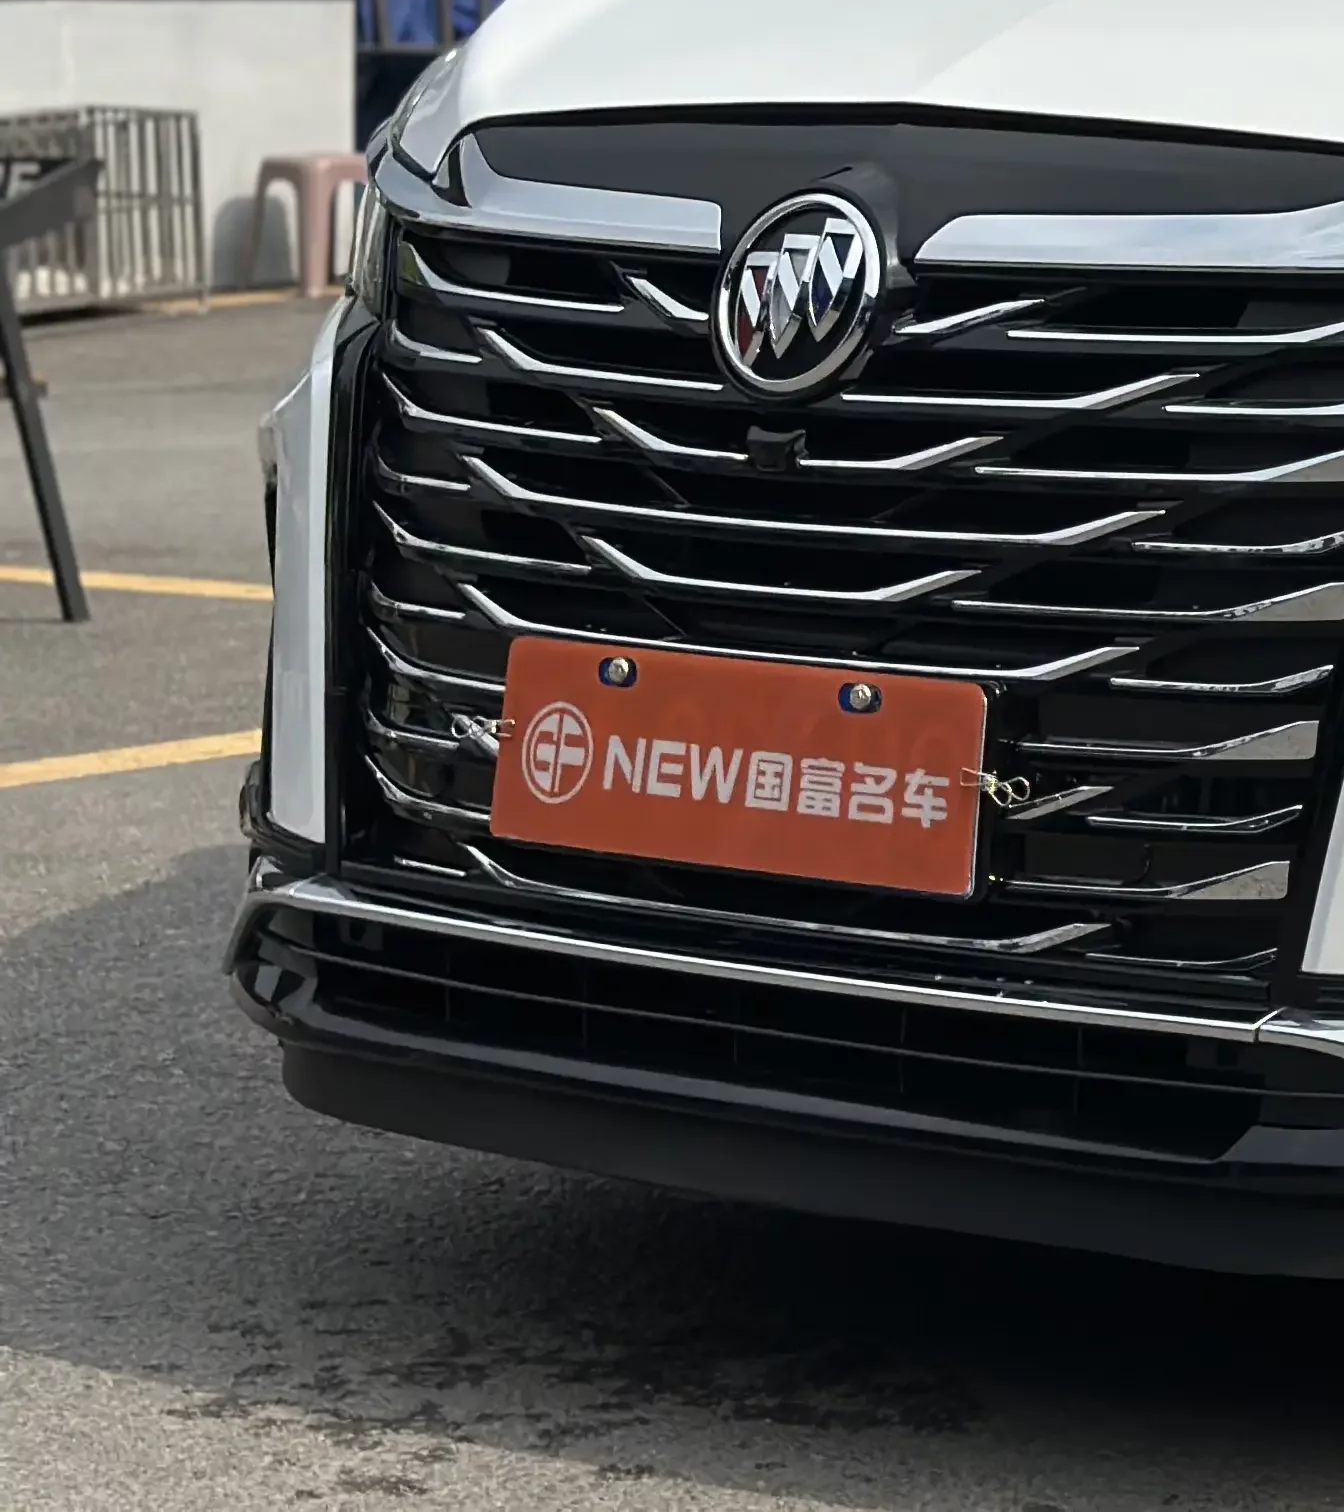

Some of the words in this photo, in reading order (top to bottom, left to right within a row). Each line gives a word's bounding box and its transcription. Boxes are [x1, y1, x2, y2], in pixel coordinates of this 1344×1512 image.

[602, 734, 743, 804] NEW
[744, 750, 950, 829] 国富名车
